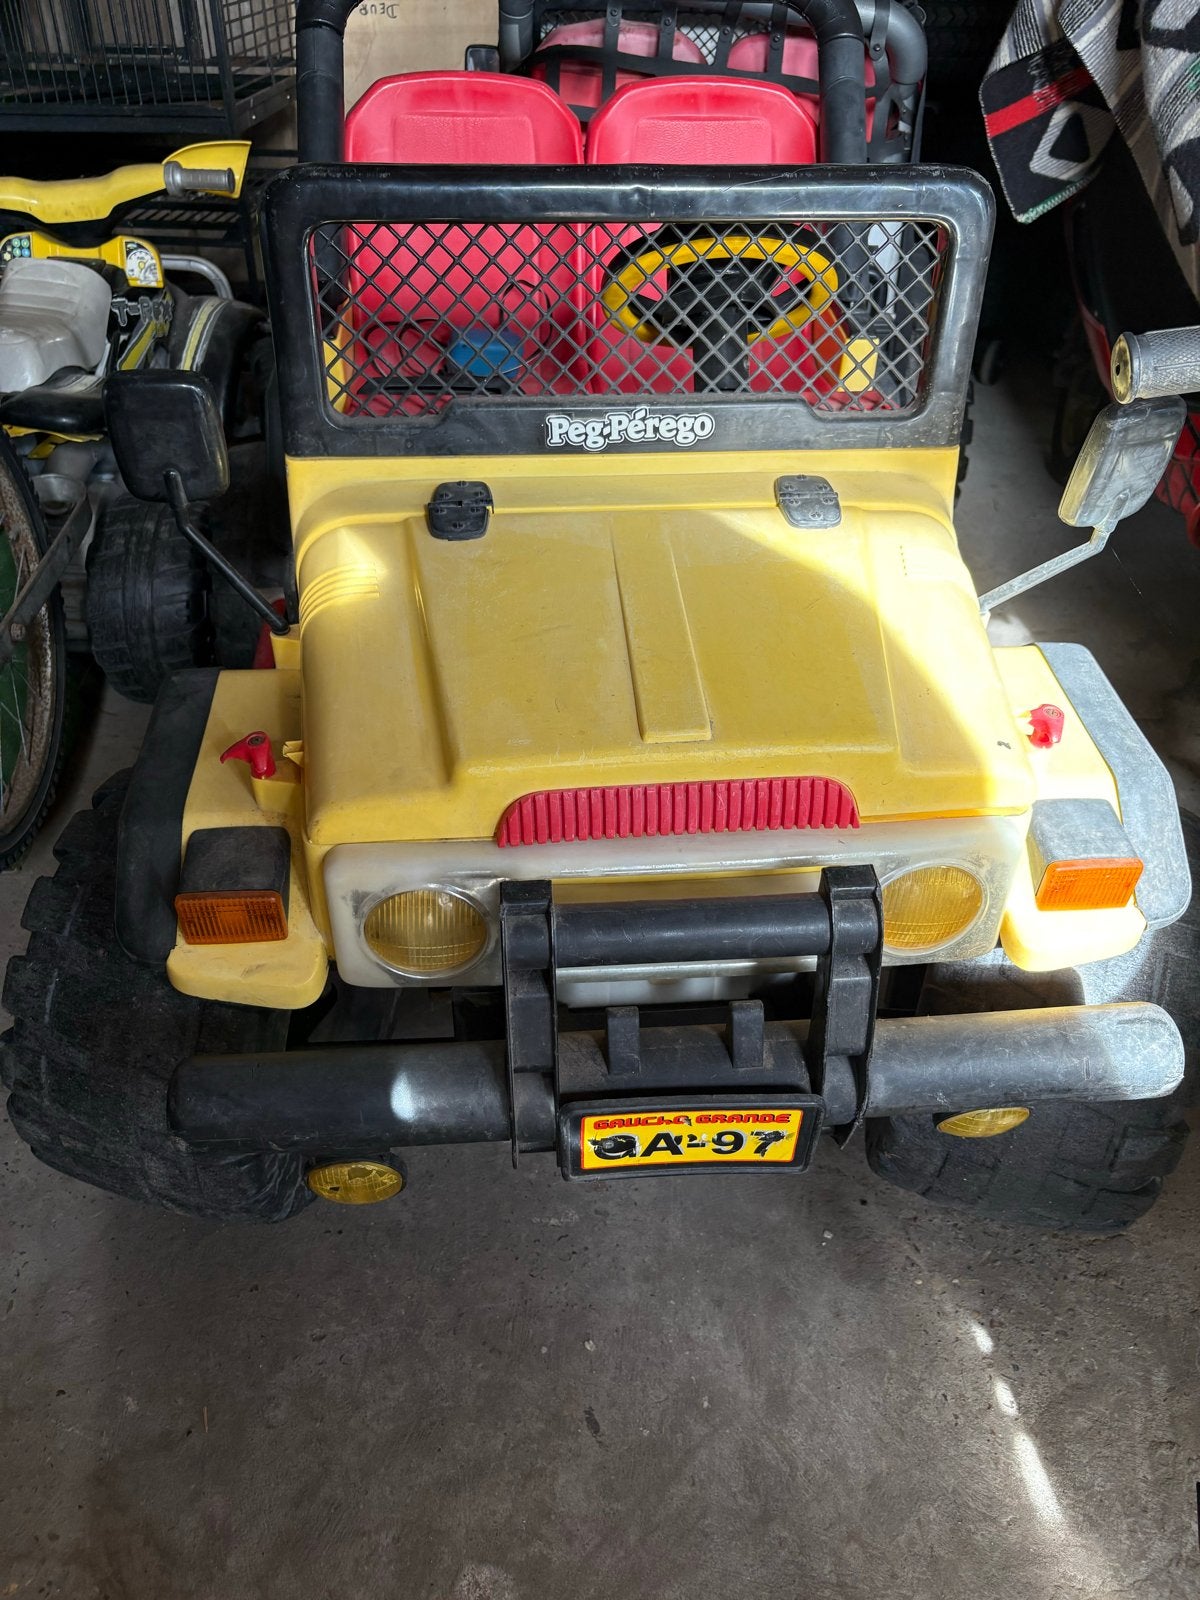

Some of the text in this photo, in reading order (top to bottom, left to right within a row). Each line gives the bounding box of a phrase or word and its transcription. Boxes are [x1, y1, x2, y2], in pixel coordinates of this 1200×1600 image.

[358, 2, 400, 19] DEUR
[547, 406, 714, 450] Peg-Pérego
[696, 1113, 791, 1124] GRANDE
